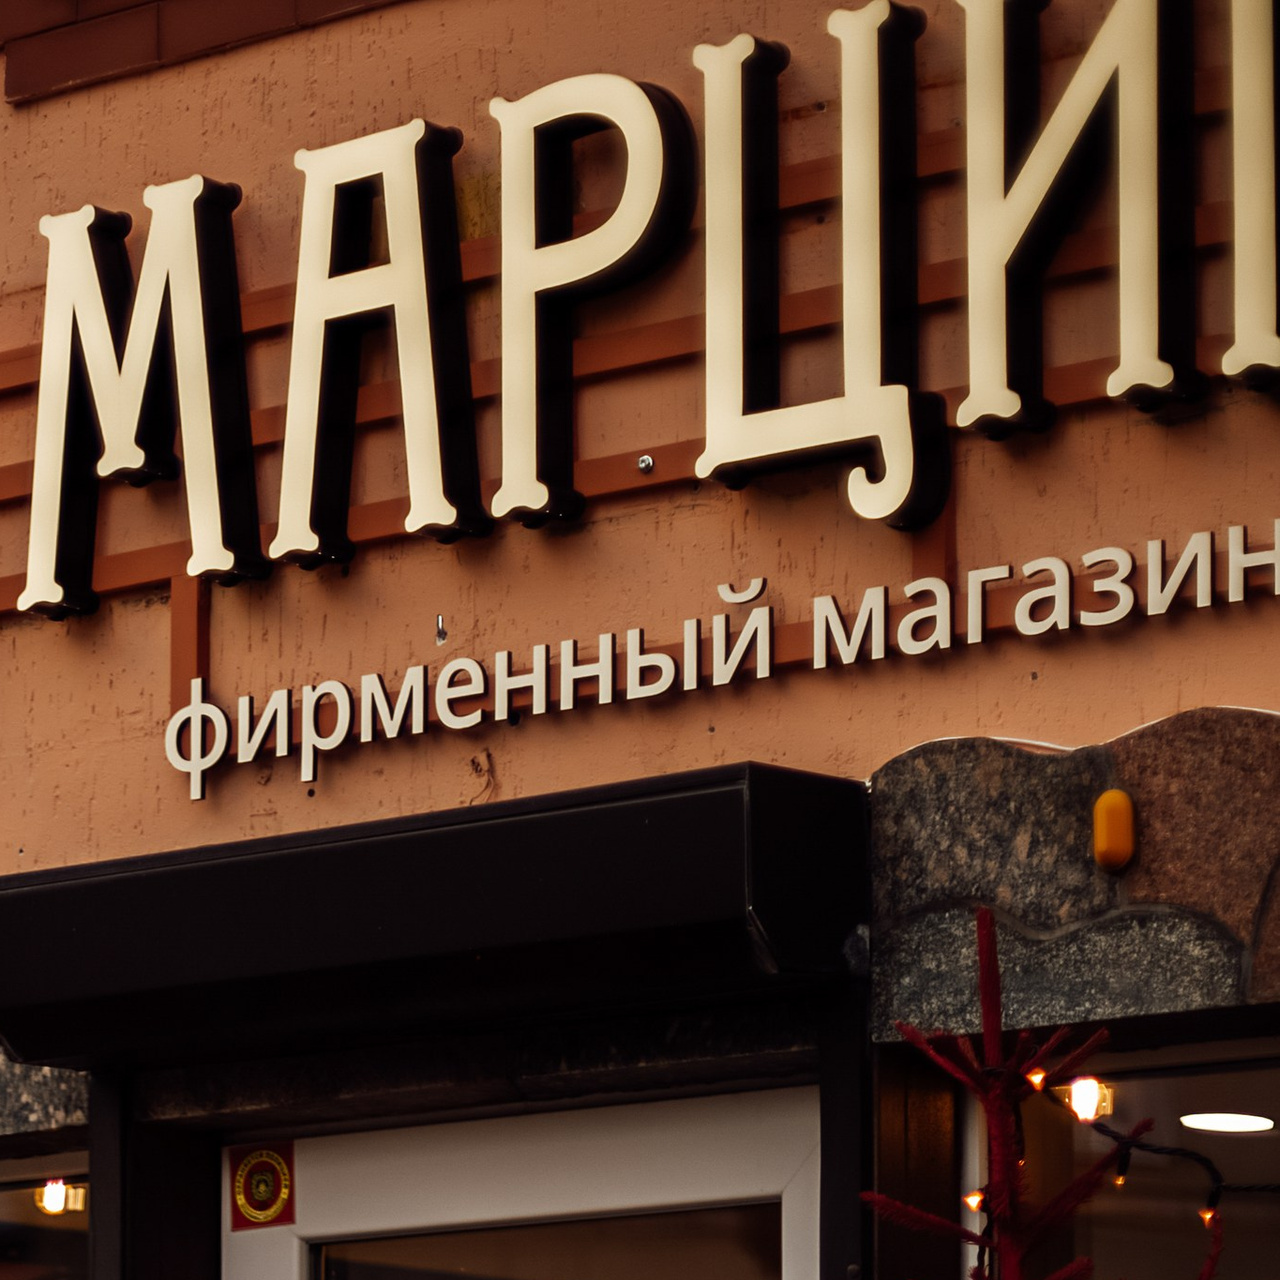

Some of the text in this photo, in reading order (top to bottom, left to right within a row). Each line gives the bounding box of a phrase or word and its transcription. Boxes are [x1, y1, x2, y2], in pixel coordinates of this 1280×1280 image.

[16, 0, 1280, 613] МАРЦИ
[164, 515, 1280, 800] фирменный магазин
